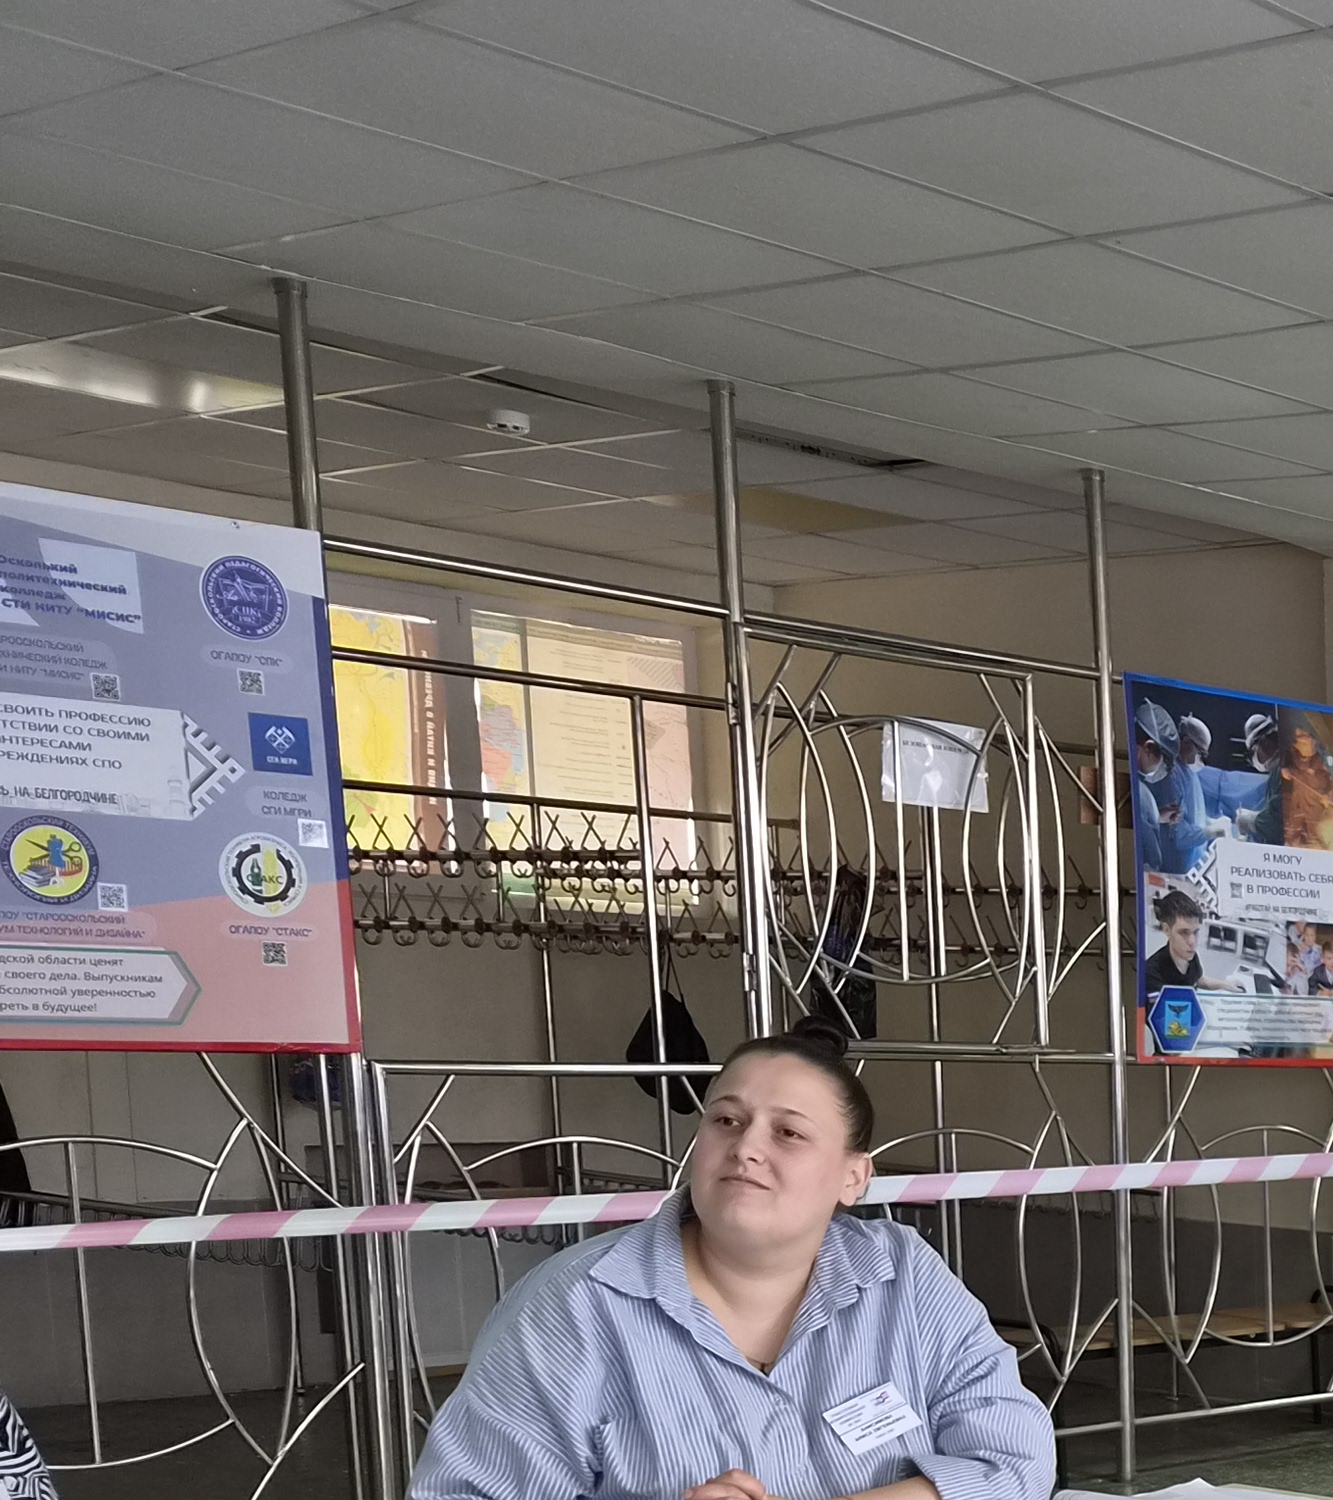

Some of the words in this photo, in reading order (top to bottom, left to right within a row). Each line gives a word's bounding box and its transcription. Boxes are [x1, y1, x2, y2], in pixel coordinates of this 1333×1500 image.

[59, 709, 151, 727] ПРОФЕССИЮ
[63, 725, 83, 736] СО
[87, 727, 150, 742] СВОИМИ
[92, 758, 122, 770] СПО
[1263, 853, 1271, 862] Я
[1273, 854, 1302, 865] МОГУ
[1231, 866, 1306, 882] РЕАЛИЗОВАТЬ
[1308, 873, 1333, 884] СЕБЯ
[1247, 884, 1254, 893] В
[1257, 885, 1320, 898] ПРОФЕССИИ
[38, 954, 86, 966] области
[89, 957, 124, 968] ценят
[4, 970, 46, 981] своего
[49, 971, 80, 983] дела.
[84, 971, 163, 984] Выпускникам
[71, 987, 156, 999] уверенностью
[32, 1003, 39, 1012] в
[42, 1001, 97, 1015] будущее!
